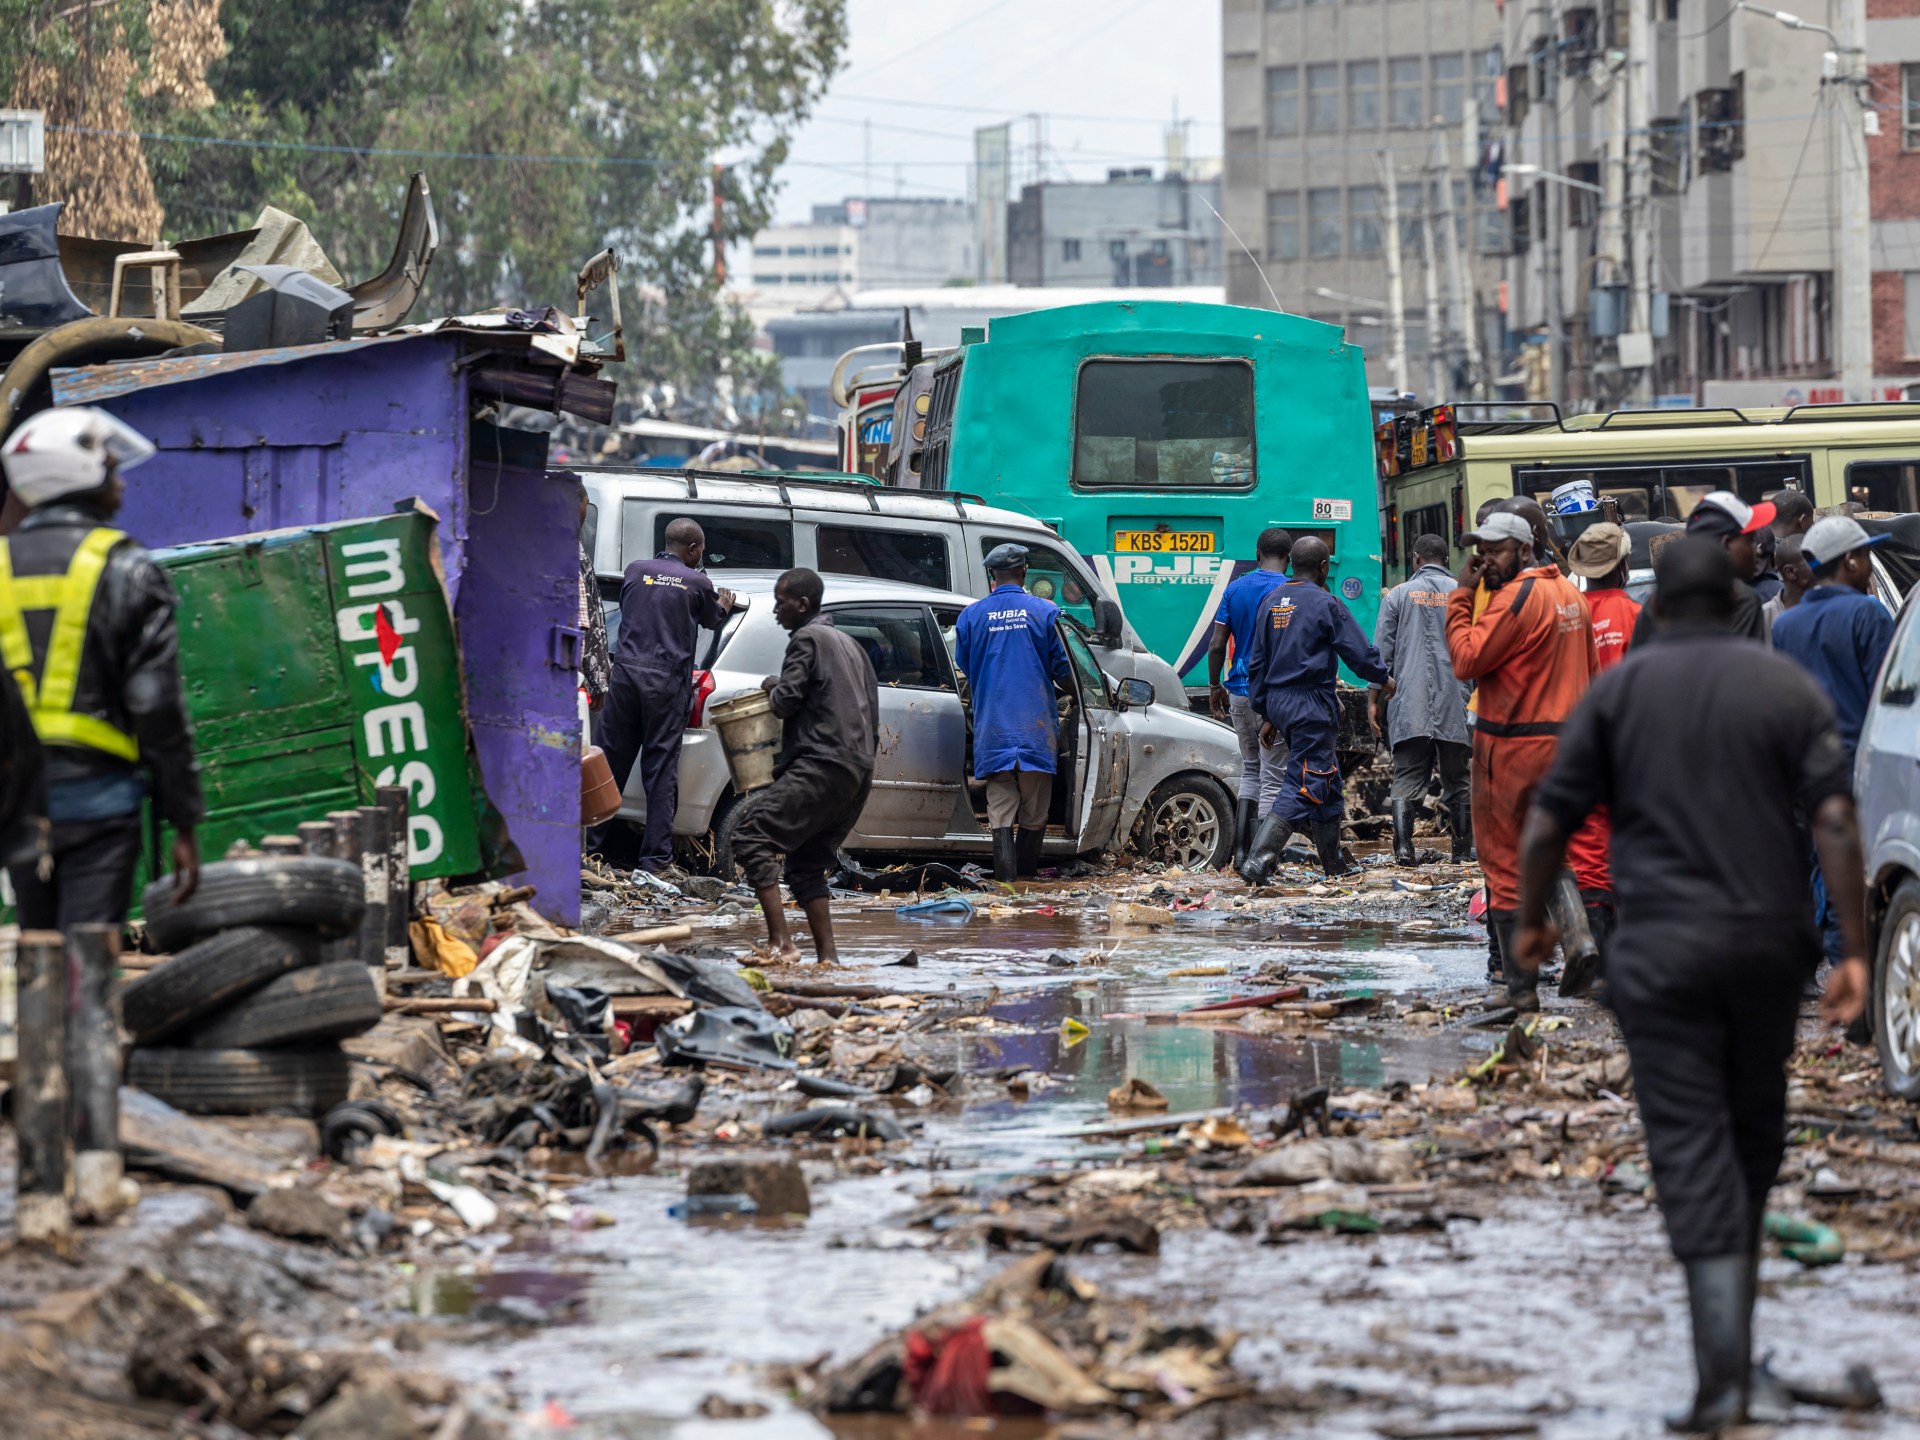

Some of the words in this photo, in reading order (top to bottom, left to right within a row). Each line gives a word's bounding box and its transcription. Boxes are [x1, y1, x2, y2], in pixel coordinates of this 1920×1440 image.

[1316, 503, 1331, 514] 80
[1130, 533, 1163, 551] KBS
[1169, 534, 1210, 552] 152D
[1114, 556, 1220, 584] PJE
[656, 574, 683, 583] Sensei
[1133, 575, 1218, 585] services
[1344, 581, 1360, 592] 80
[988, 609, 1027, 620] RUBIA
